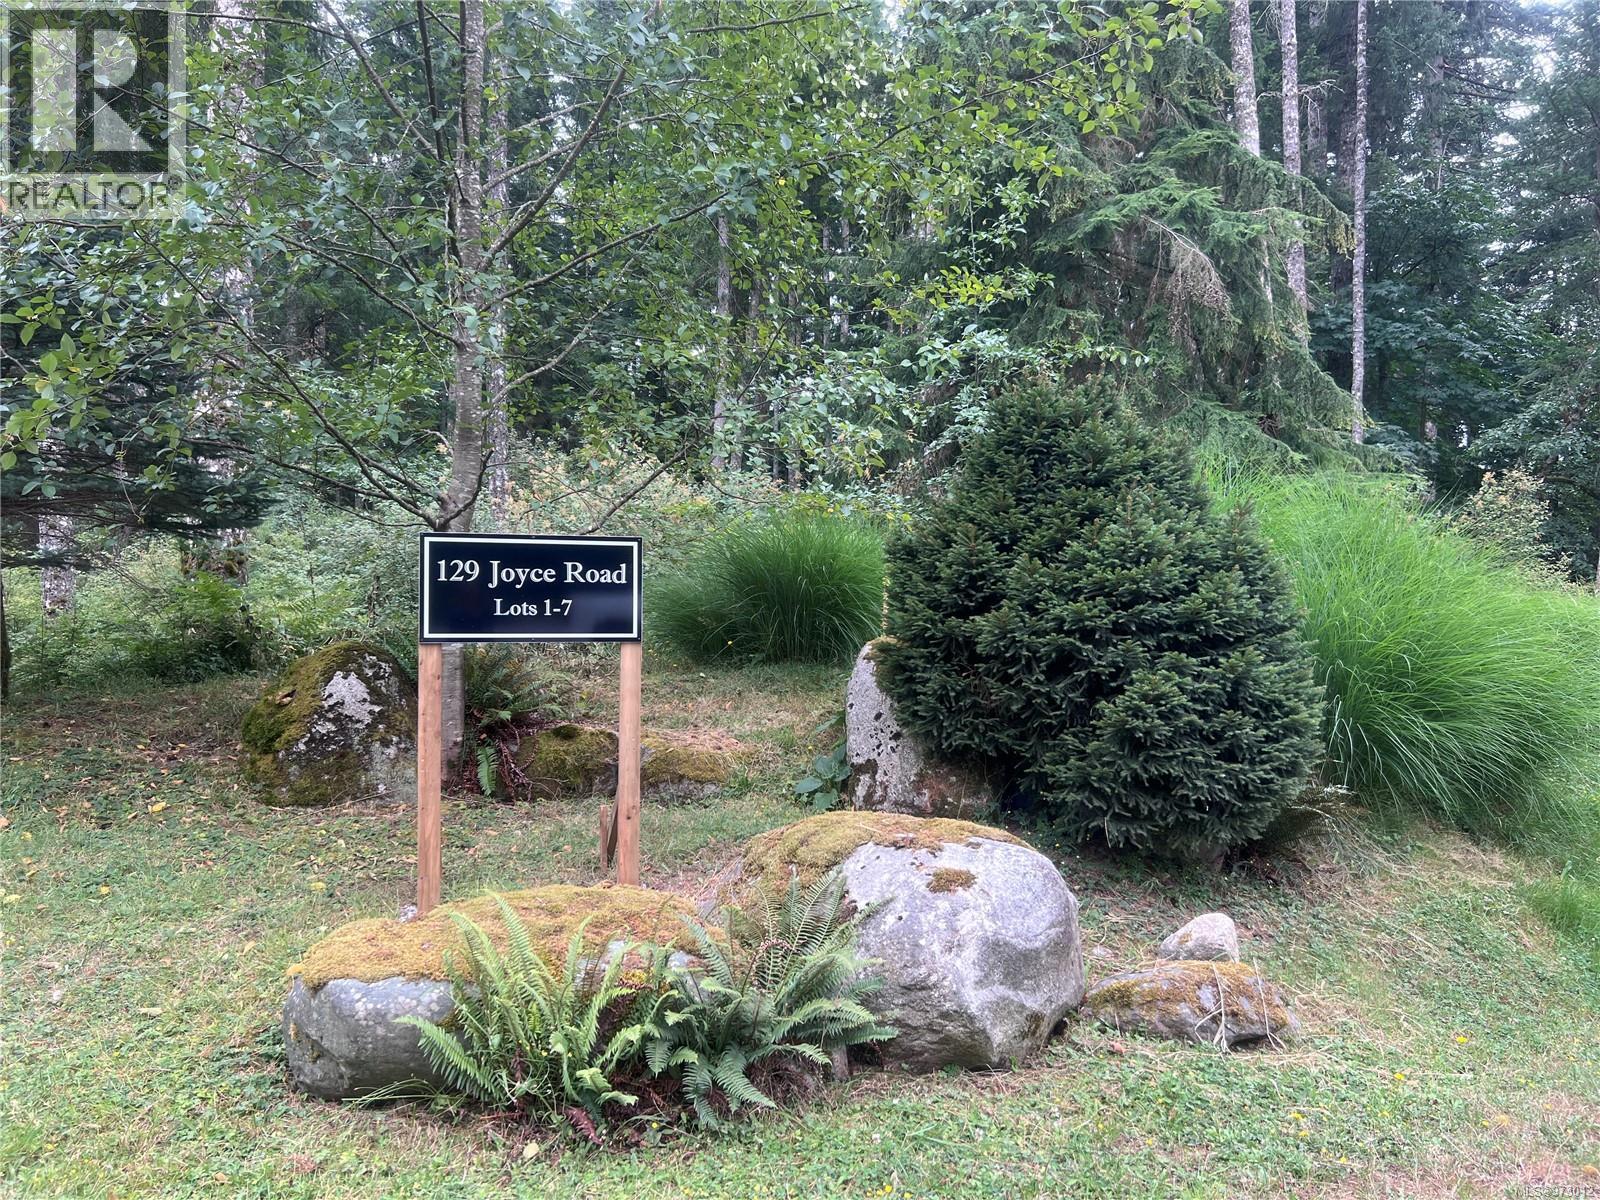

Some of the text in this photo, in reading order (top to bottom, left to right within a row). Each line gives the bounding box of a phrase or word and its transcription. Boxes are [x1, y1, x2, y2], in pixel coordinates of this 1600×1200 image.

[437, 559, 628, 589] 129 Joyce Road
[493, 598, 573, 616] Lots 1-7
